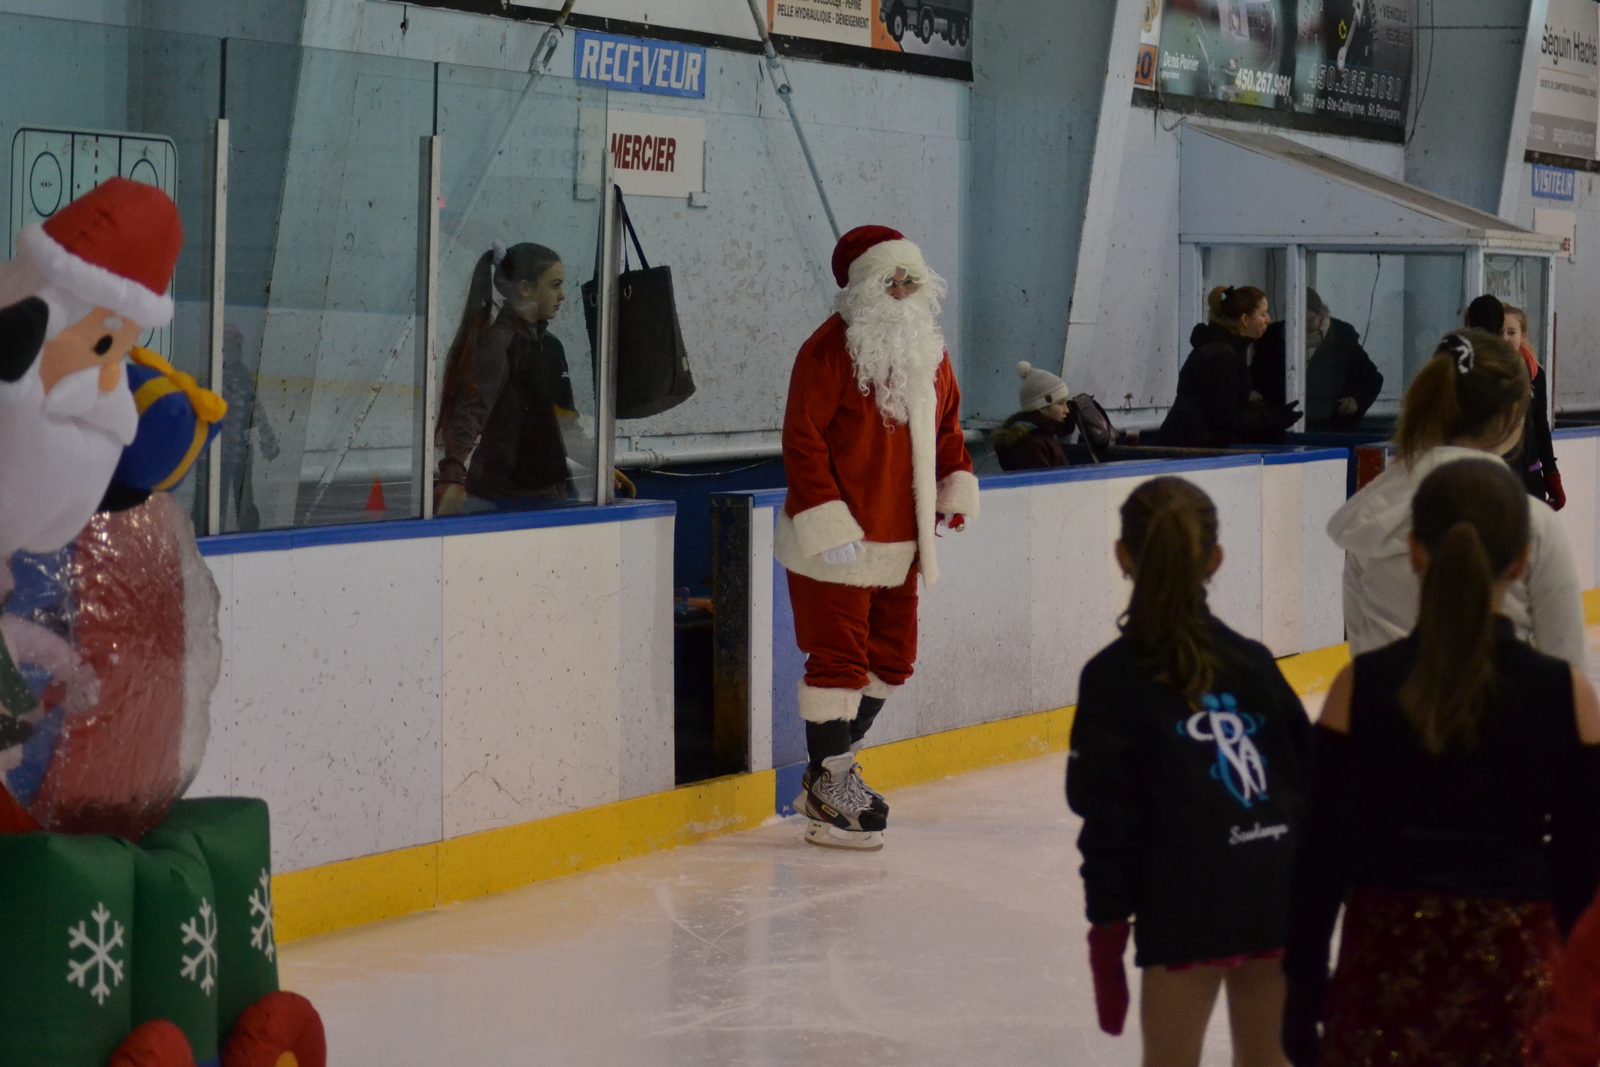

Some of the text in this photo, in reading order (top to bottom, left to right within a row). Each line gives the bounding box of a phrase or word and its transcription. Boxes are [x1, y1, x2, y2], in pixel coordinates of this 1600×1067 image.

[777, 4, 793, 17] PELLE
[794, 7, 832, 24] HYDRAULIQUE
[611, 132, 677, 173] MERCIER
[1534, 168, 1574, 196] VISITEUR
